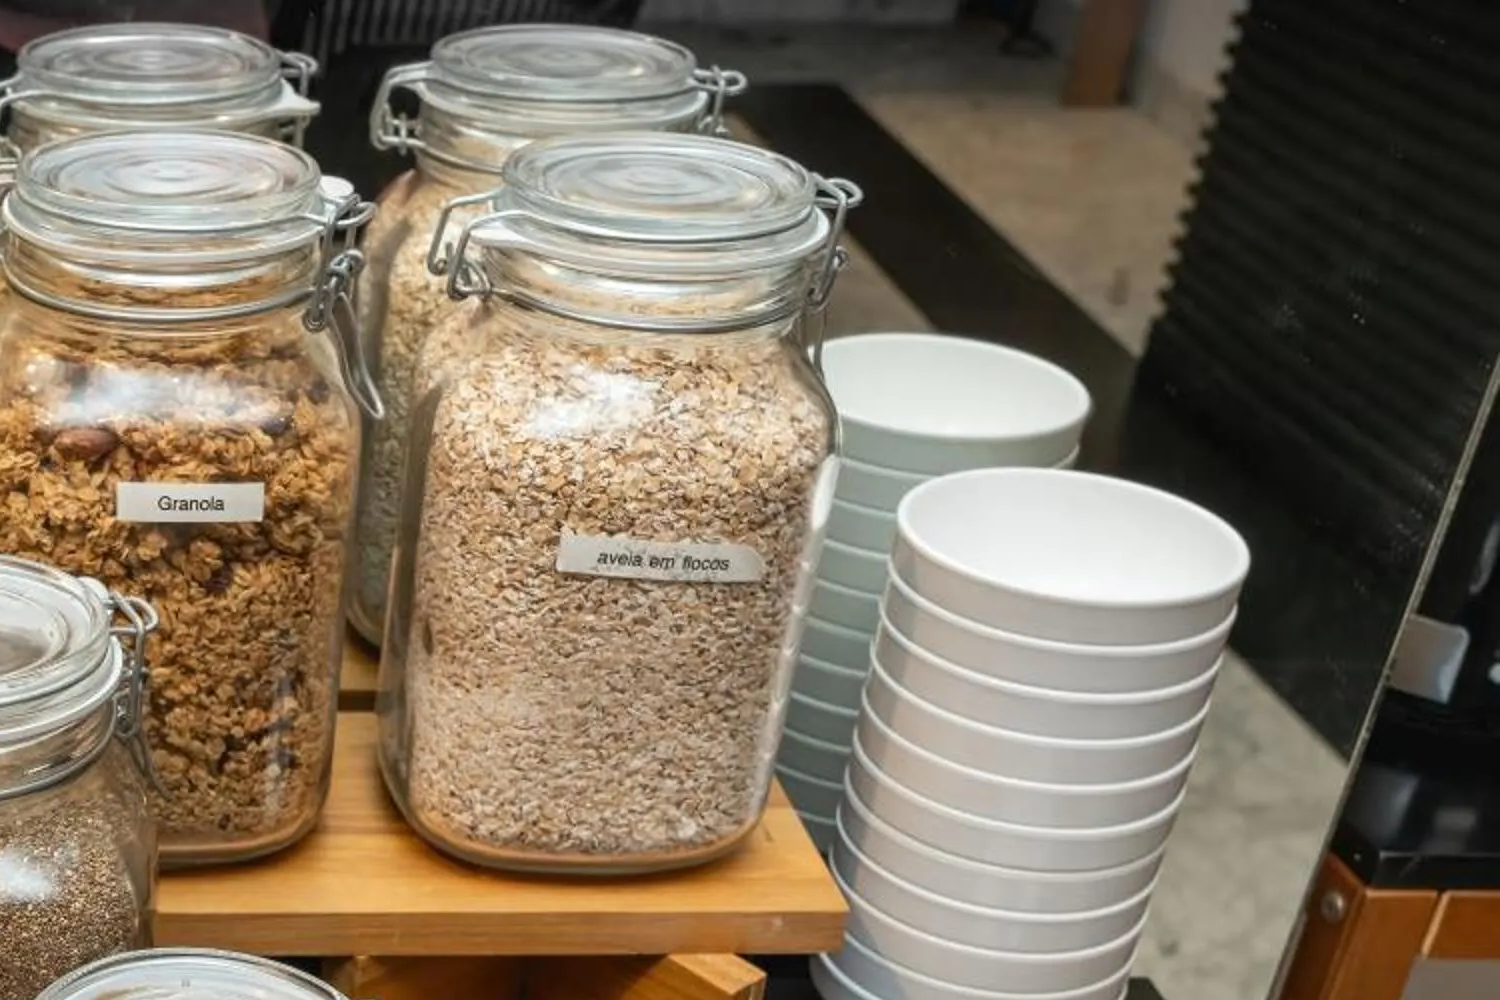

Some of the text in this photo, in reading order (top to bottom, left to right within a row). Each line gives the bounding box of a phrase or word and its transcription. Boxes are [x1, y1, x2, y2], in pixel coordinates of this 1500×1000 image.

[157, 495, 225, 512] Granola
[597, 551, 643, 569] aveia
[649, 556, 675, 571] em
